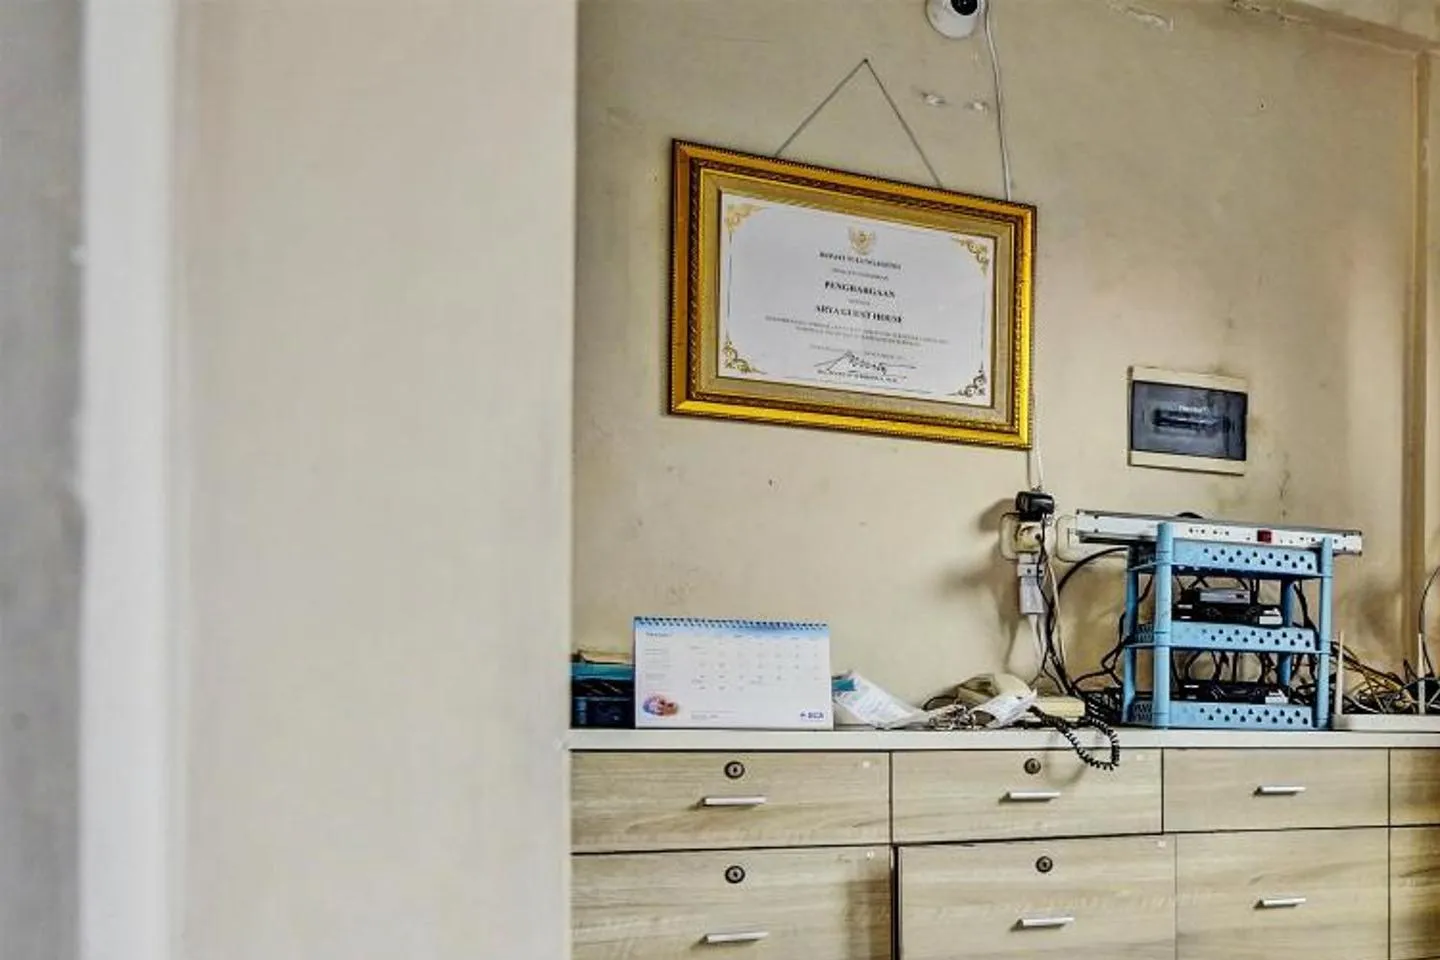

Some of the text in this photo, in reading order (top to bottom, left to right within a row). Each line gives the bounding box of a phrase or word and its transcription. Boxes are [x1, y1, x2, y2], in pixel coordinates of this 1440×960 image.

[825, 280, 895, 298] PENGHARGAAN
[816, 304, 902, 323] ARYA GUEST HOUSE
